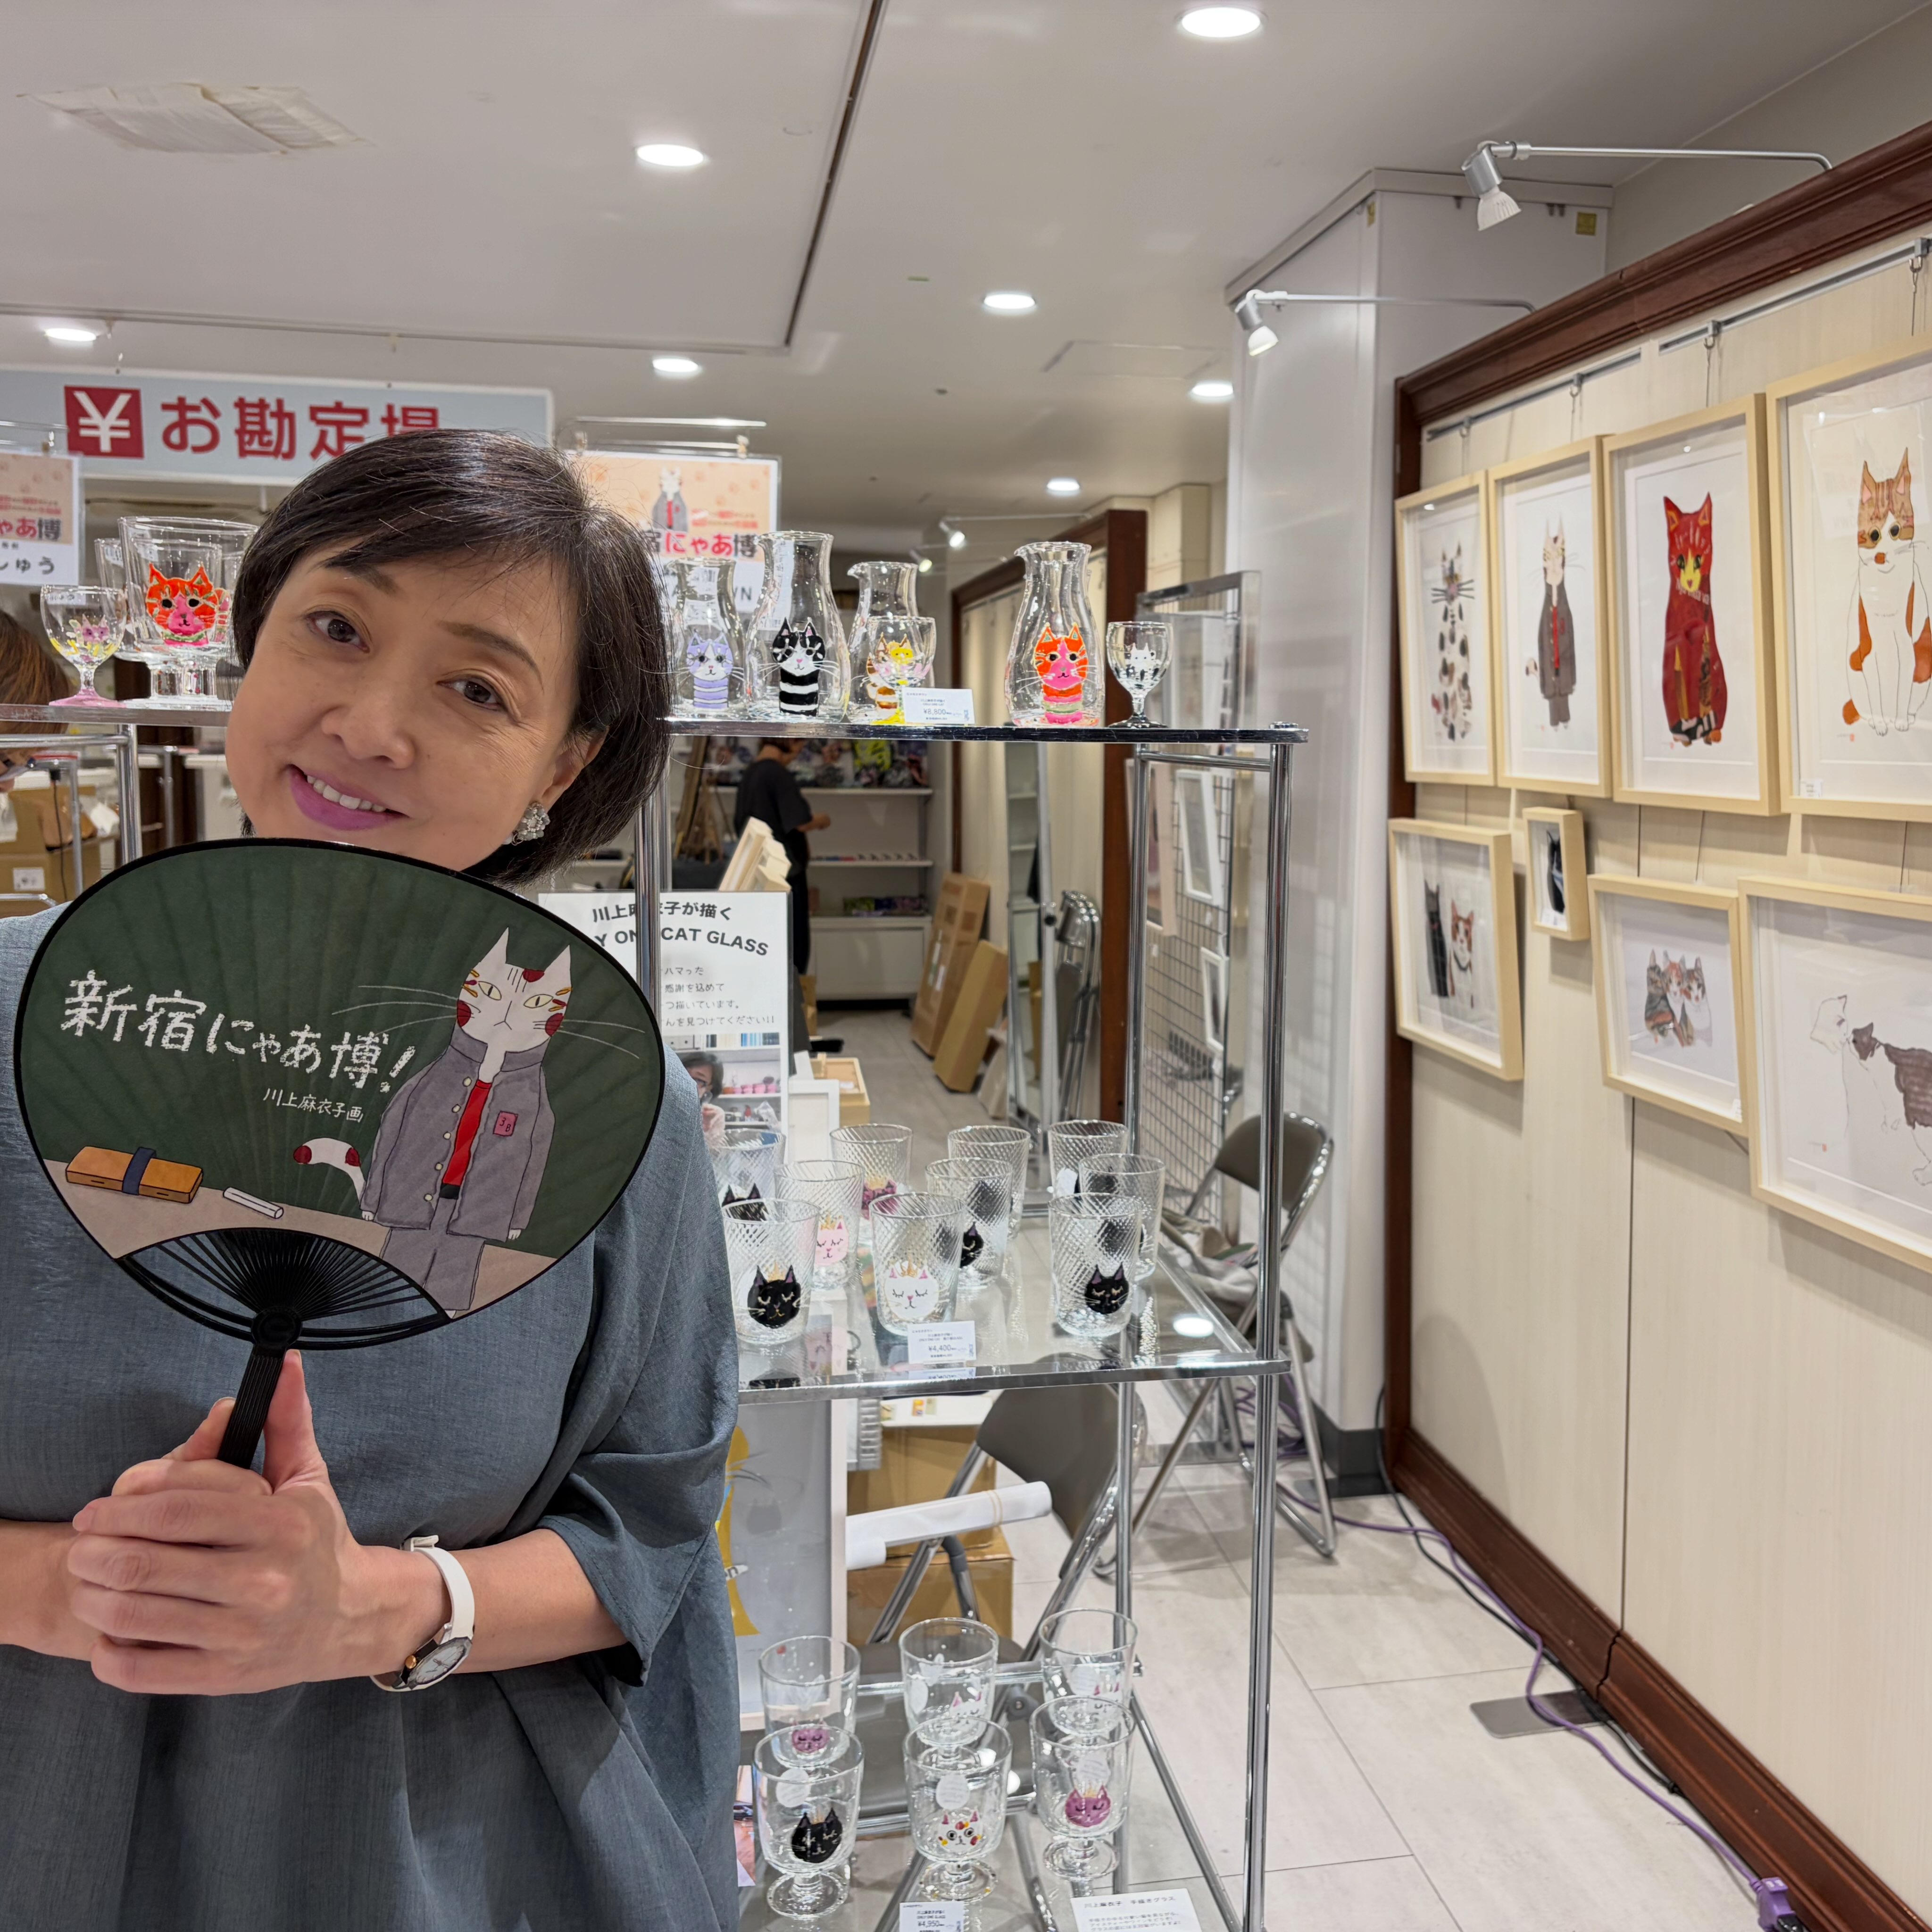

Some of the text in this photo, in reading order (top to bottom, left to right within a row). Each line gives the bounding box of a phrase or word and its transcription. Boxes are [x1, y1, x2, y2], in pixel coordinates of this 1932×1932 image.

[592, 901, 732, 923] 川上子が描く
[661, 927, 701, 941] CAT
[707, 931, 769, 956] GLASS
[60, 970, 416, 1093] 新宿にゃあ博!
[263, 1088, 364, 1123] 川上麻衣子画
